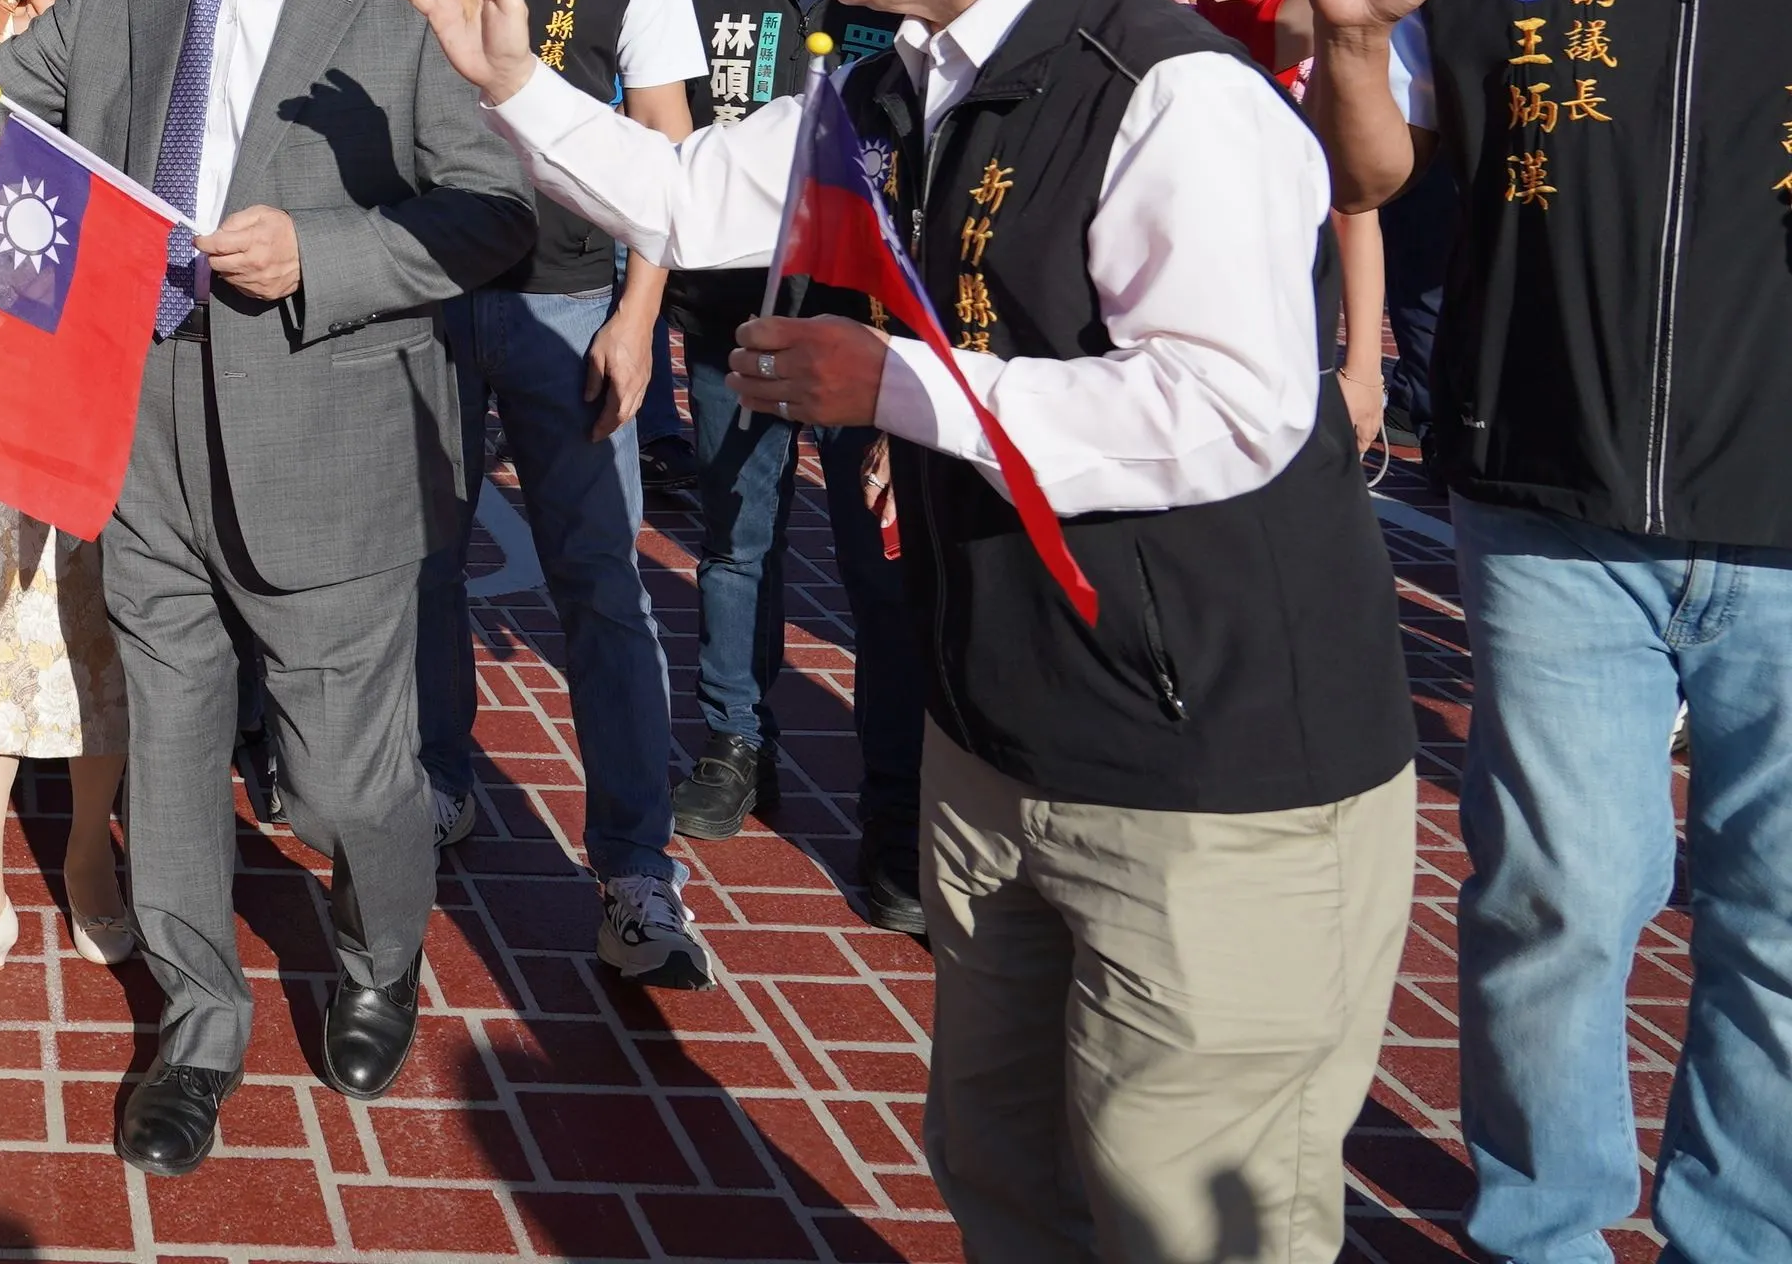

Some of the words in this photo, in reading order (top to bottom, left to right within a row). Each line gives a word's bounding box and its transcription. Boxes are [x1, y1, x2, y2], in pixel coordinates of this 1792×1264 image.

[755, 15, 779, 96] 新竹縣議員
